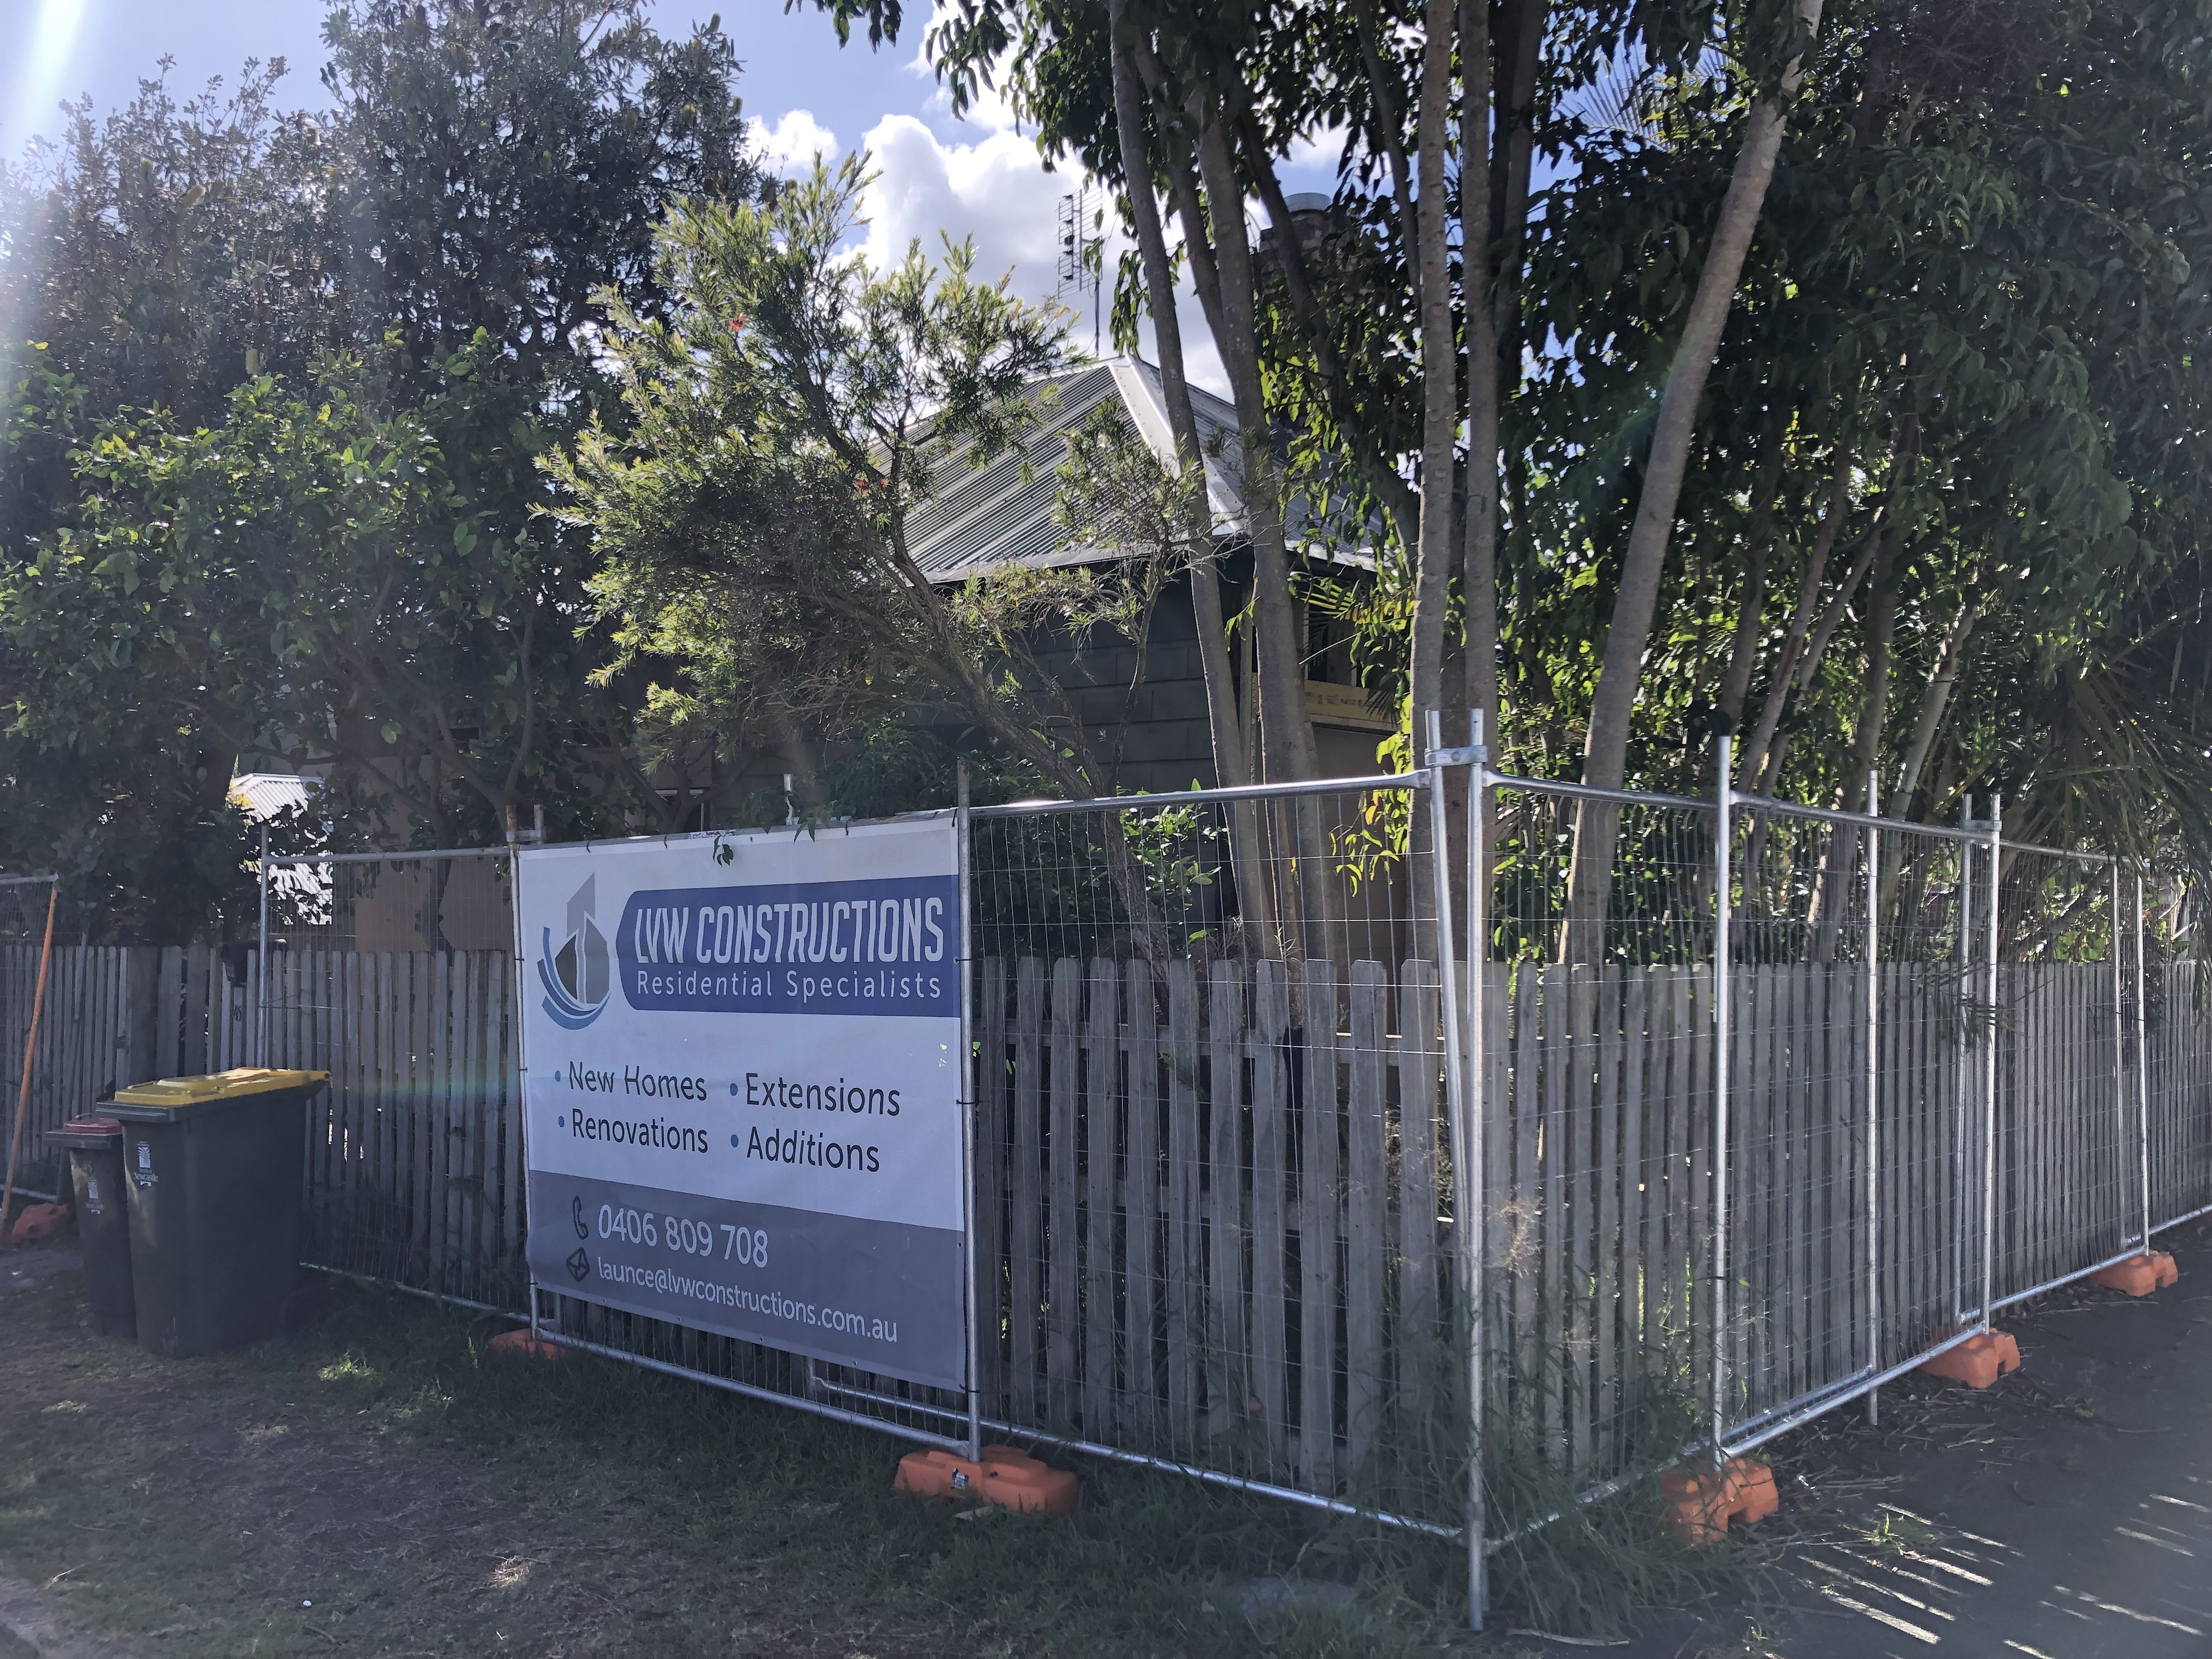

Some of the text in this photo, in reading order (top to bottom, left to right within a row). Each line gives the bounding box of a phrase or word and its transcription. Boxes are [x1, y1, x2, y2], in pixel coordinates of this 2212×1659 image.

[635, 897, 944, 964] LVW CONSTRUCTIONS
[637, 970, 941, 1003] Residential Specialists
[569, 1061, 707, 1101] New Homes
[746, 1073, 900, 1116] Extensions
[572, 1108, 708, 1154] Renovations
[747, 1126, 879, 1172] Additions
[599, 1204, 768, 1268] 0406 809 708
[598, 1256, 898, 1342] launce@lvwconstructions.com.au
